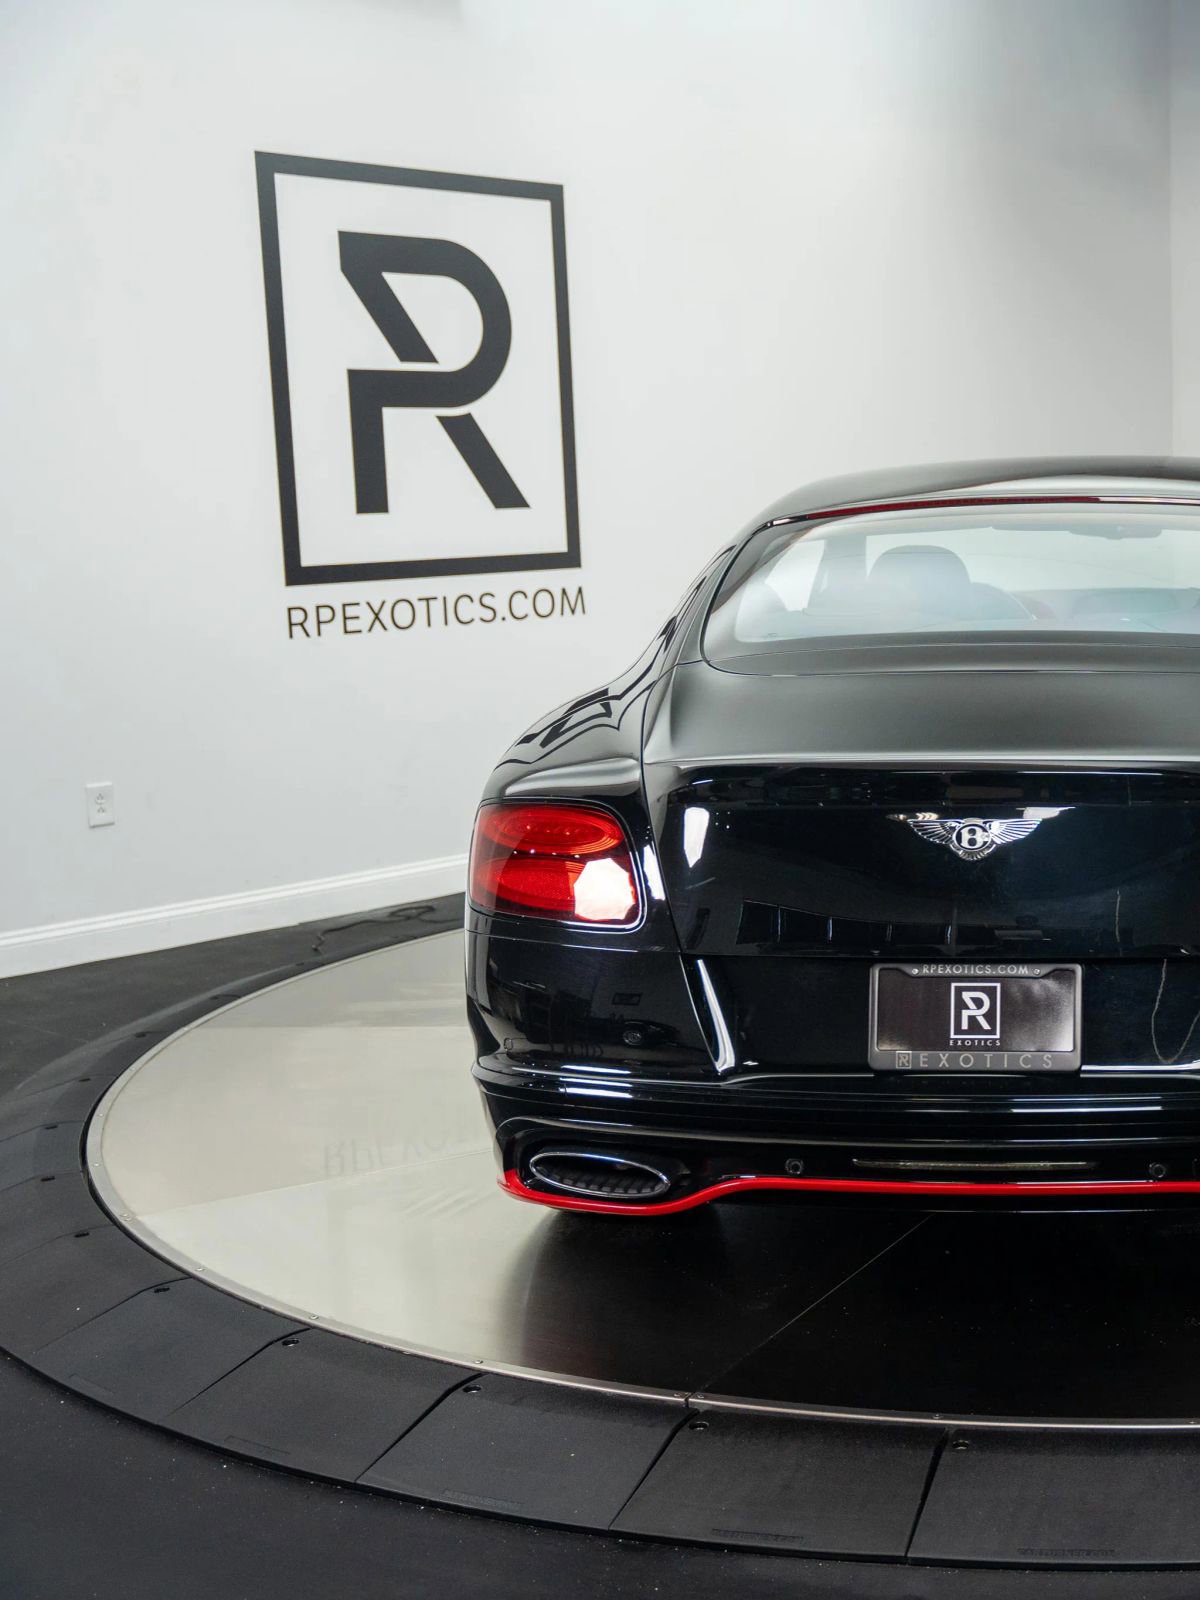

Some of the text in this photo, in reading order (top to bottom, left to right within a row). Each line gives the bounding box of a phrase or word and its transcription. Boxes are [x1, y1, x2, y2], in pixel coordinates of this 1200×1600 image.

[286, 585, 587, 640] RPEXOTICS.COM
[922, 964, 1029, 976] RPEXOTICS.COM
[919, 1053, 1053, 1069] EXOTICS
